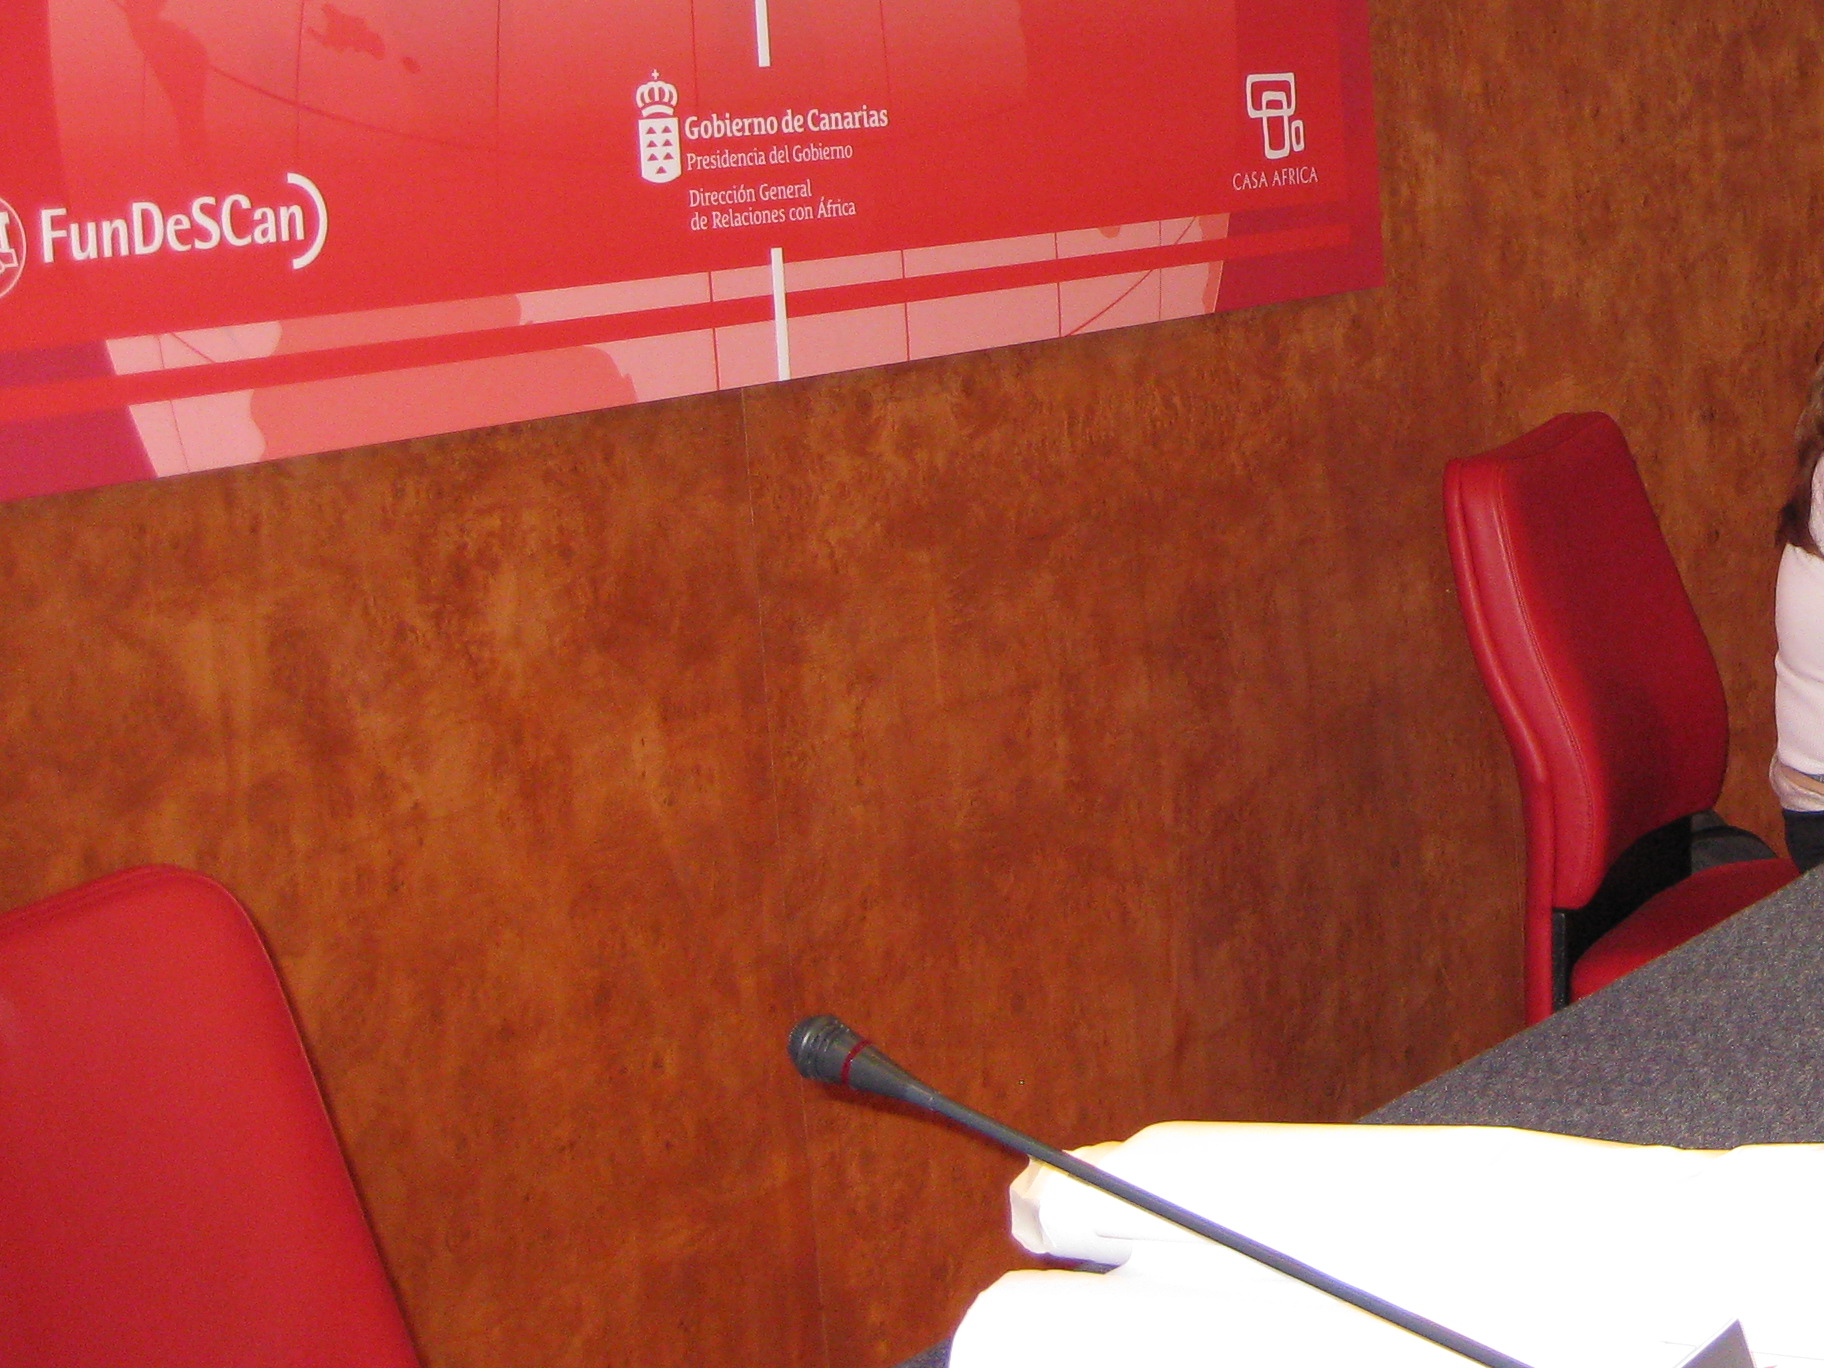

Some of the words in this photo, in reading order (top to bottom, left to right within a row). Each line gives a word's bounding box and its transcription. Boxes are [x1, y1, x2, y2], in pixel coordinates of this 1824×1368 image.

[684, 112, 778, 140] Gobierno
[781, 108, 804, 134] de
[807, 104, 889, 132] Canarias
[686, 147, 767, 171] Presidencia
[769, 145, 790, 165] del
[792, 143, 853, 163] Gobierno
[1232, 171, 1269, 191] CASA
[1271, 166, 1319, 187] AFRICA
[689, 183, 756, 208] Dirección
[759, 179, 812, 203] General
[690, 213, 708, 231] de
[712, 204, 786, 229] Relaciones
[788, 205, 814, 223] con
[817, 196, 856, 219] África
